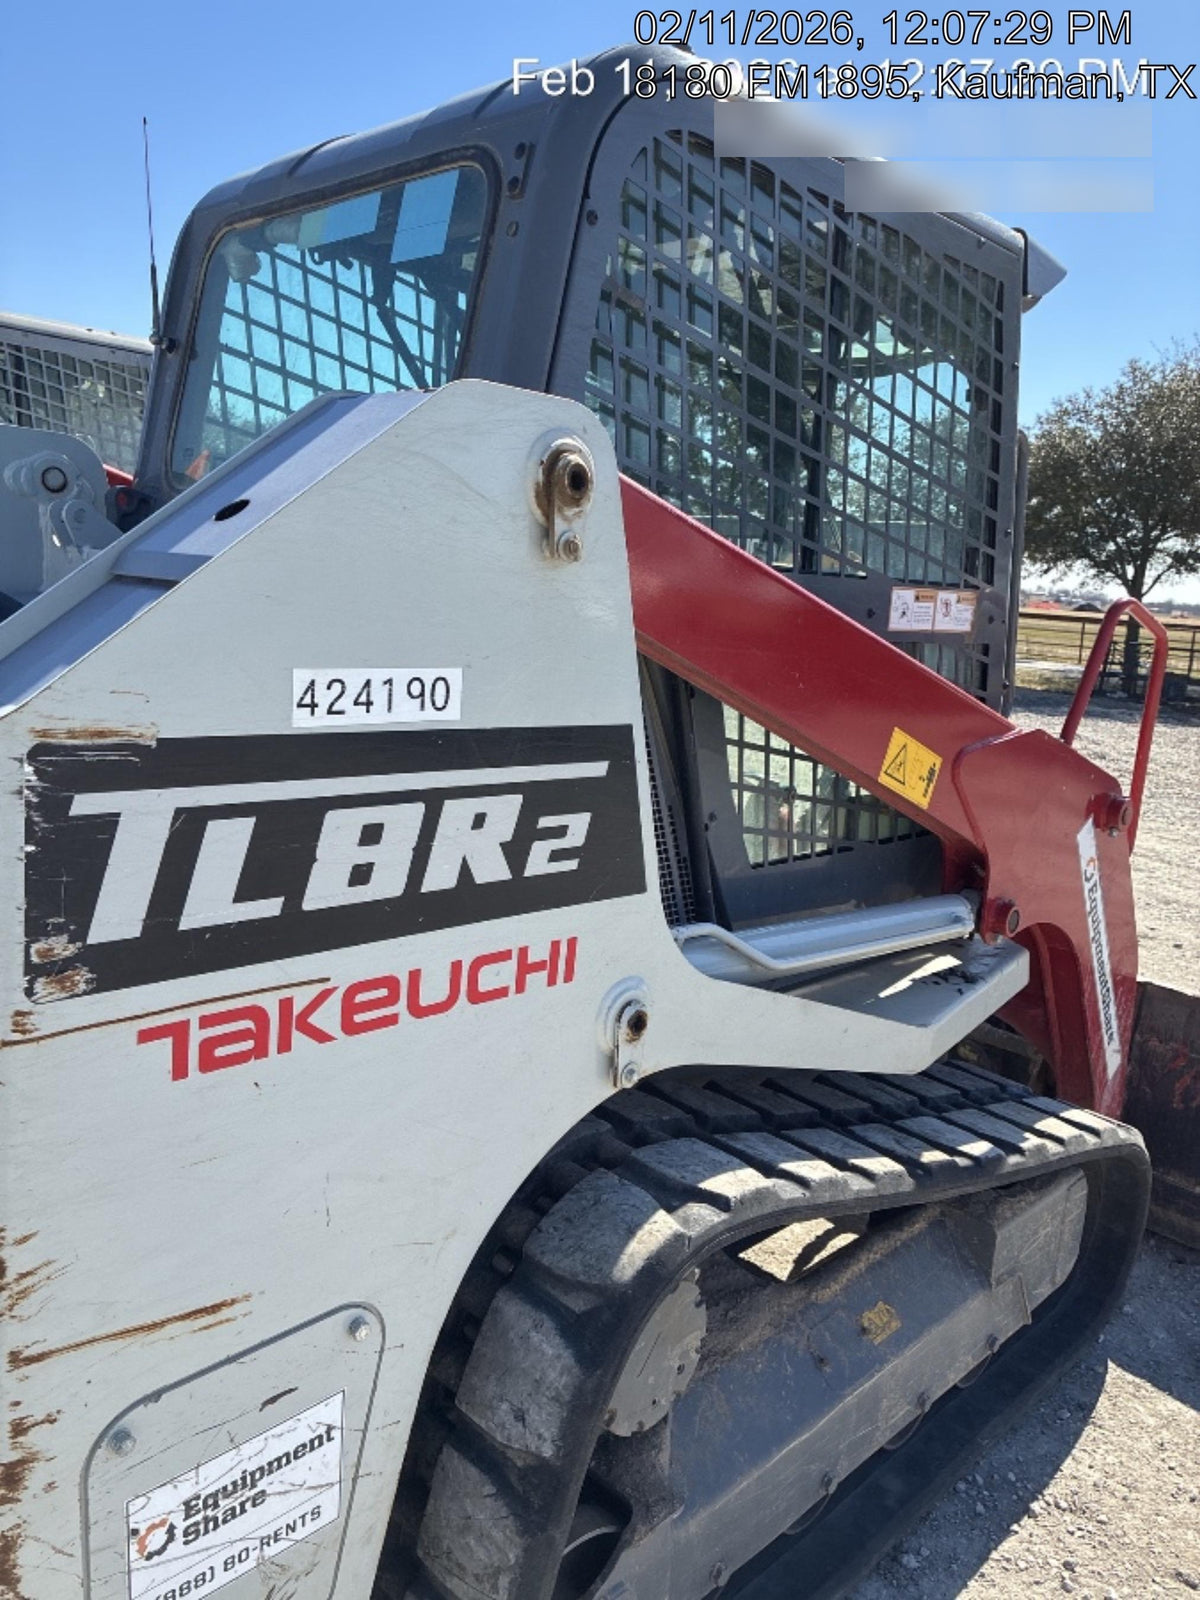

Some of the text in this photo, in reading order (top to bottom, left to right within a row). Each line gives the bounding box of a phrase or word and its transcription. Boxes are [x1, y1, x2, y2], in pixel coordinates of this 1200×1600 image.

[295, 676, 451, 716] 424190
[68, 760, 610, 946] TL8R2
[182, 1424, 336, 1522] Equipment
[182, 1488, 268, 1546] Share
